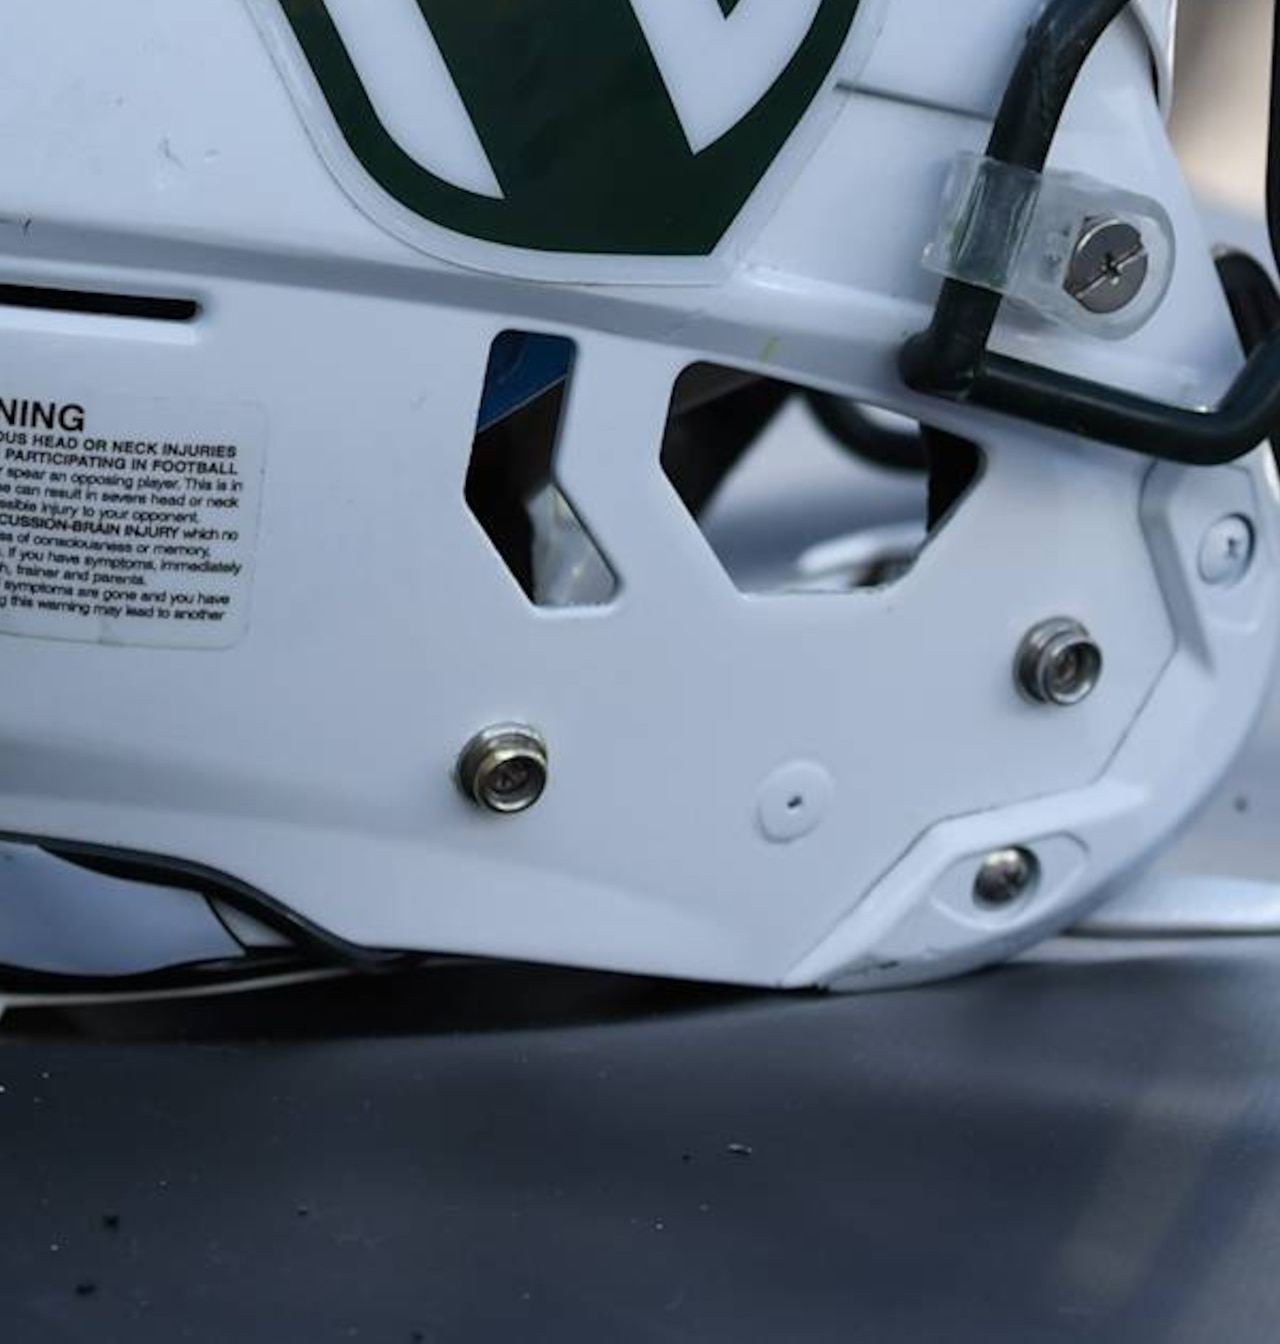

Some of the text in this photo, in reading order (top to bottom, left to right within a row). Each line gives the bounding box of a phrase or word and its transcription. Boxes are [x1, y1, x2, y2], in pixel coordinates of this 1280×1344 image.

[32, 433, 77, 449] HEAD
[83, 439, 107, 451] OR
[112, 441, 157, 455] NECK
[162, 443, 237, 457] INJURIES
[5, 448, 125, 470] PARTICIPATING
[131, 459, 146, 470] IN
[152, 460, 238, 475] FOOTBALL
[7, 466, 45, 481] spear
[49, 471, 66, 482] an
[71, 473, 133, 491] opposing
[185, 477, 212, 491] This
[217, 479, 227, 491] is
[231, 480, 242, 491] in
[15, 485, 40, 496] can
[44, 486, 81, 500] result
[86, 489, 97, 500] in
[151, 493, 185, 507] head
[190, 498, 203, 507] or
[207, 497, 239, 508] neck
[41, 502, 77, 518] injury
[83, 506, 94, 517] to
[99, 508, 128, 523] your
[17, 533, 30, 543] of
[33, 535, 132, 553] consciousness
[136, 543, 150, 554] or
[124, 524, 180, 538] INJURY
[183, 528, 219, 540] which
[222, 530, 238, 541] no
[16, 564, 60, 578] trainer
[64, 570, 89, 582] and
[20, 550, 43, 562] you
[48, 552, 79, 564] have
[160, 559, 242, 576] immediately
[4, 580, 73, 595] symptoms
[78, 587, 98, 598] are
[103, 588, 137, 601] gone
[141, 591, 167, 602] and
[170, 593, 194, 606] you
[198, 592, 230, 605] have
[11, 595, 33, 607] this
[37, 600, 89, 615] warning
[93, 605, 122, 618] may
[126, 606, 154, 618] lead
[158, 608, 170, 619] to
[174, 609, 225, 621] another
